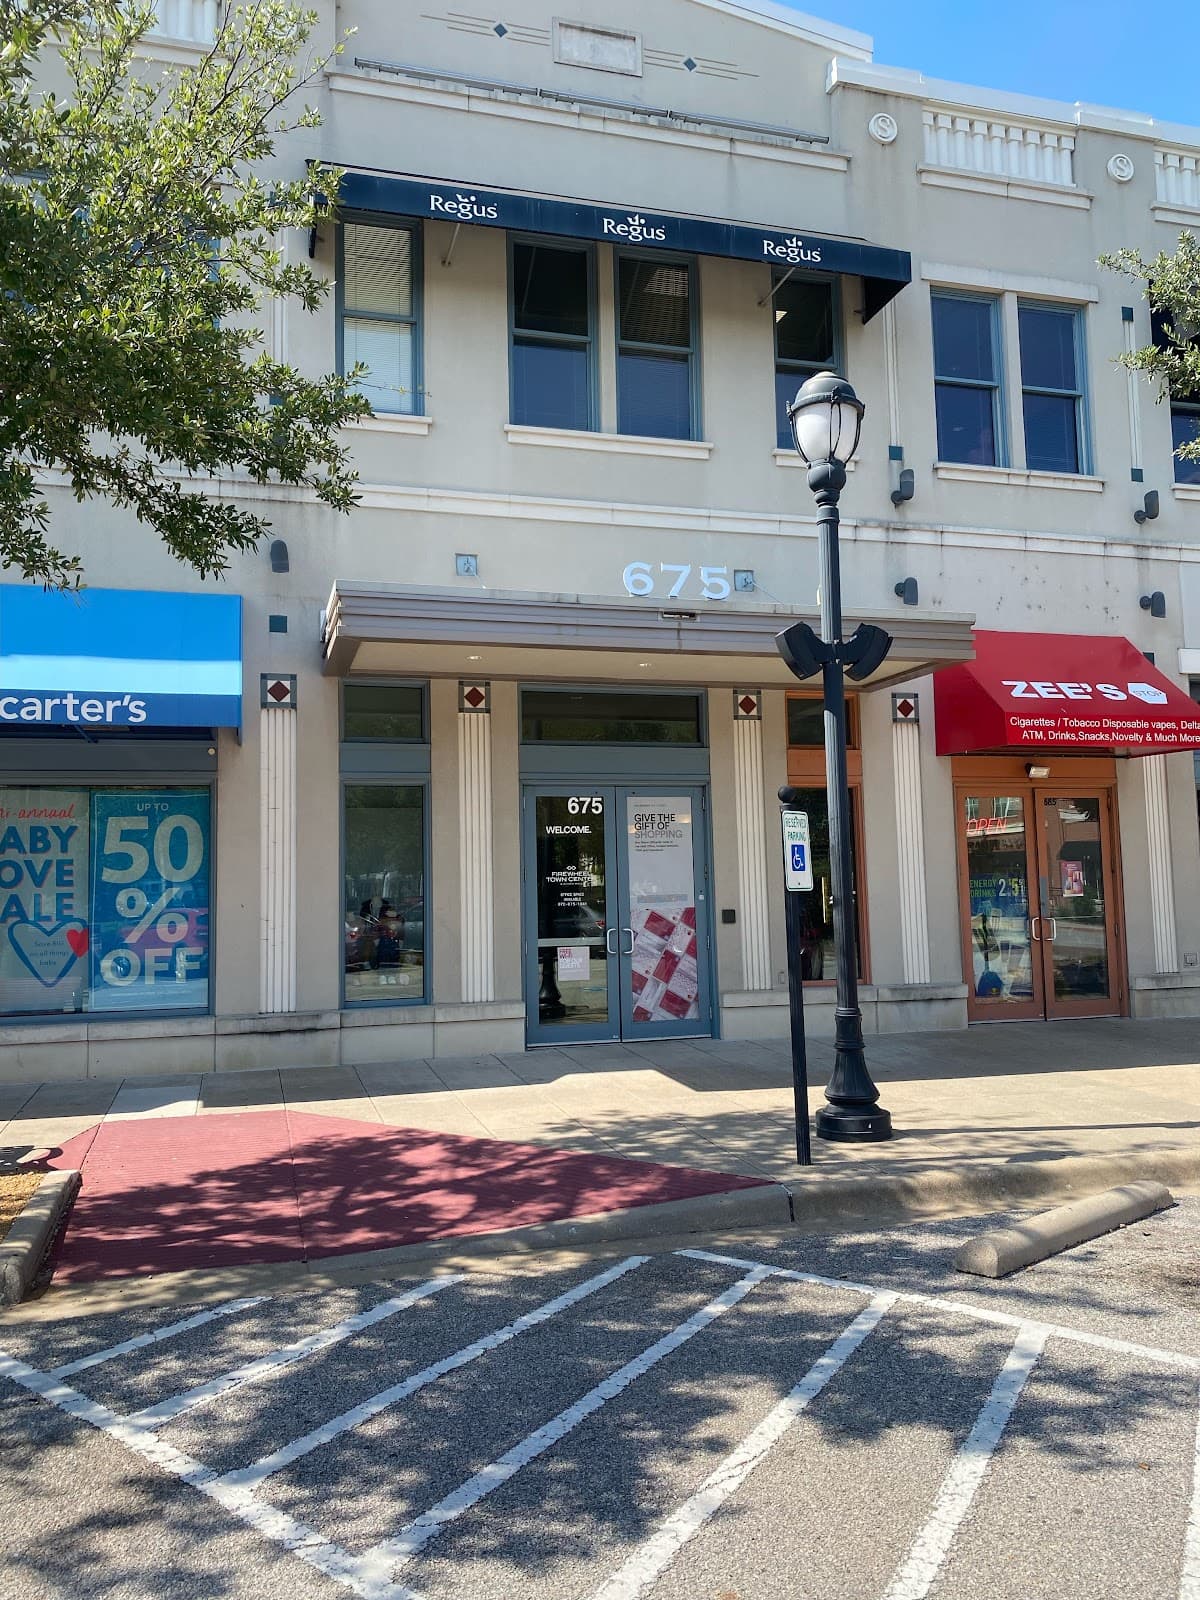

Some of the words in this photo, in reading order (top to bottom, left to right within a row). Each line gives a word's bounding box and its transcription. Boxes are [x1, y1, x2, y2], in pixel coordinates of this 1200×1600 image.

[429, 194, 498, 220] Regus
[602, 215, 666, 242] Regus
[762, 239, 822, 264] Regus
[622, 561, 730, 600] 675
[1000, 680, 1128, 701] ZEE'S
[1132, 689, 1162, 697] STOP
[0, 692, 147, 723] carter's
[1009, 716, 1056, 728] Cigarettes
[1063, 717, 1100, 728] Tobacco
[1102, 718, 1149, 731] Disposable
[1151, 721, 1179, 732] vapes,
[1180, 720, 1200, 730] Delta
[1022, 731, 1046, 740] ATM,
[1145, 733, 1152, 742] &
[1154, 733, 1178, 742] Much
[1179, 734, 1200, 742] More
[136, 803, 150, 812] UP
[153, 803, 169, 812] TO
[567, 796, 603, 815] 675
[634, 813, 656, 822] GIVE
[657, 813, 676, 822] THE
[545, 825, 593, 834] WELCOME.
[634, 822, 655, 831] GIFT
[657, 822, 670, 831] OF
[967, 818, 1009, 834] OPEN
[634, 830, 683, 839] SHOPPING
[787, 831, 807, 842] PARKING
[101, 814, 204, 884] 50
[969, 879, 996, 888] ENERGY
[970, 888, 996, 897] DRINKS
[116, 887, 189, 944] %
[100, 947, 204, 987] OFF
